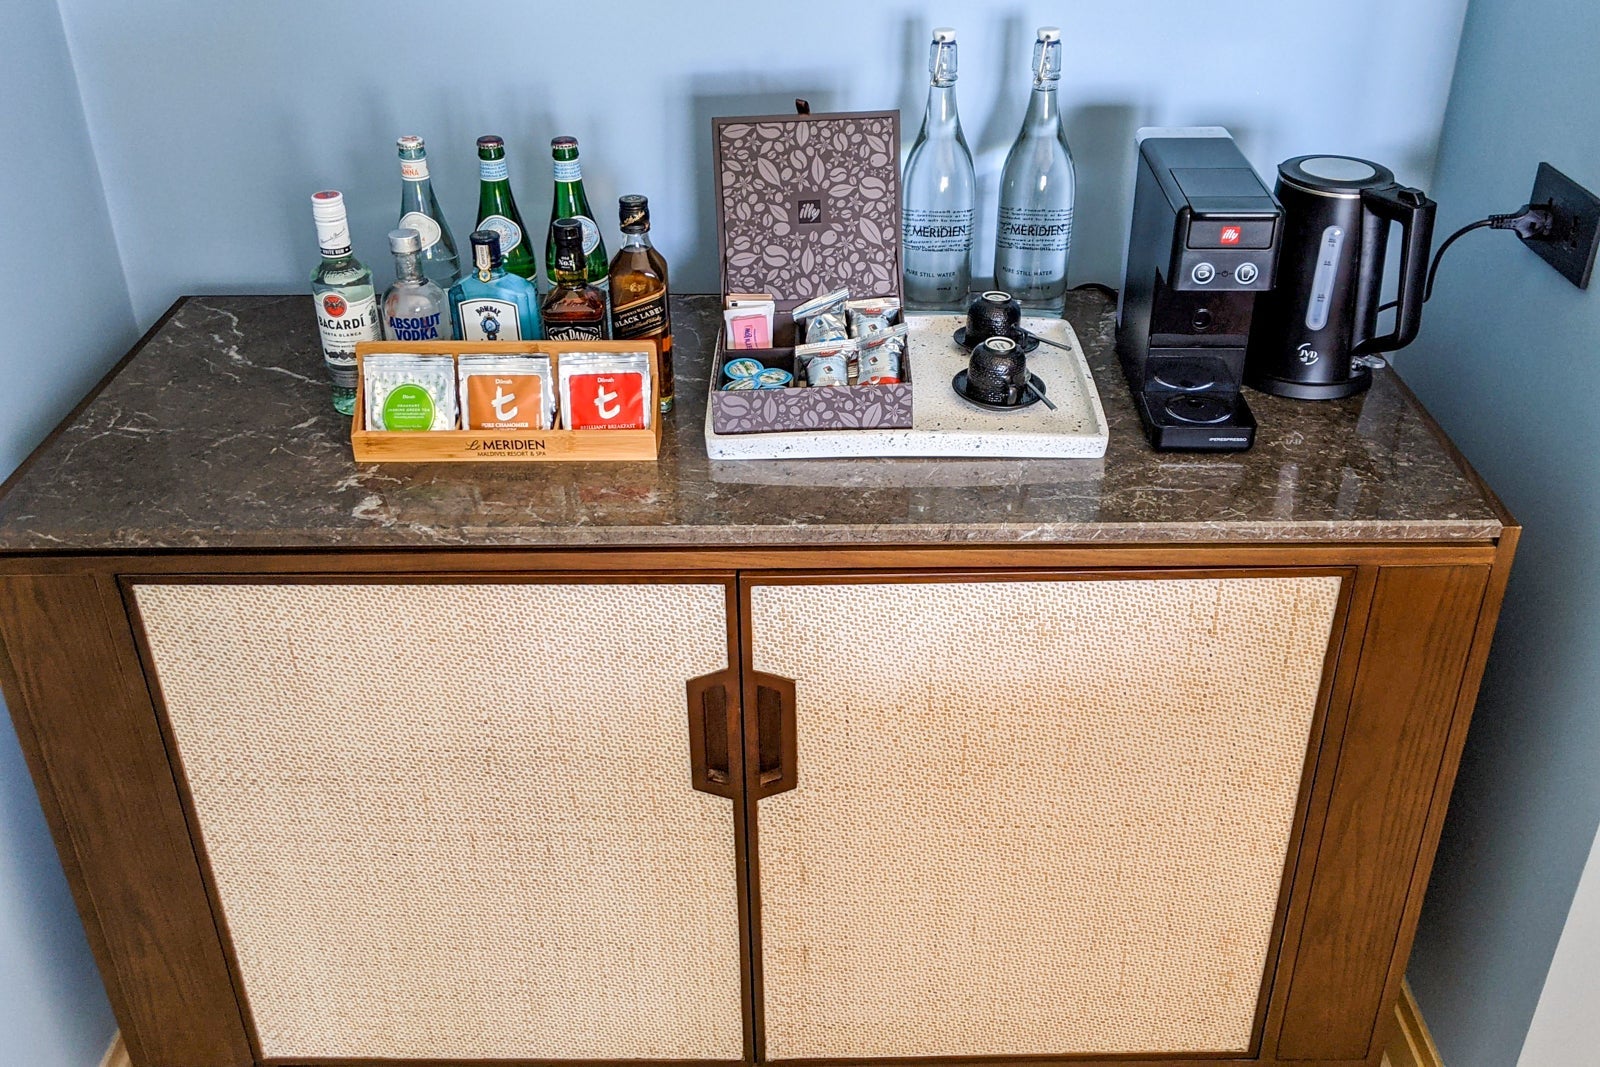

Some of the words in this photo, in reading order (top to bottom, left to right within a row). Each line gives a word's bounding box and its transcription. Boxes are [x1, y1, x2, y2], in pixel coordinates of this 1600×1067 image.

[799, 203, 820, 222] illy
[912, 225, 966, 238] MERIDIEN
[1010, 224, 1064, 237] MERIDIEN
[1222, 228, 1239, 242] illy
[475, 305, 502, 316] BOMBAY
[614, 315, 640, 328] BLACK
[639, 306, 664, 319] LABEL
[318, 313, 366, 330] BACARDÍ
[389, 312, 441, 330] ABSOLUT
[394, 326, 439, 340] VODKA
[1299, 349, 1318, 359] JVD
[465, 439, 482, 451] Le
[483, 439, 546, 450] MERIDIEN
